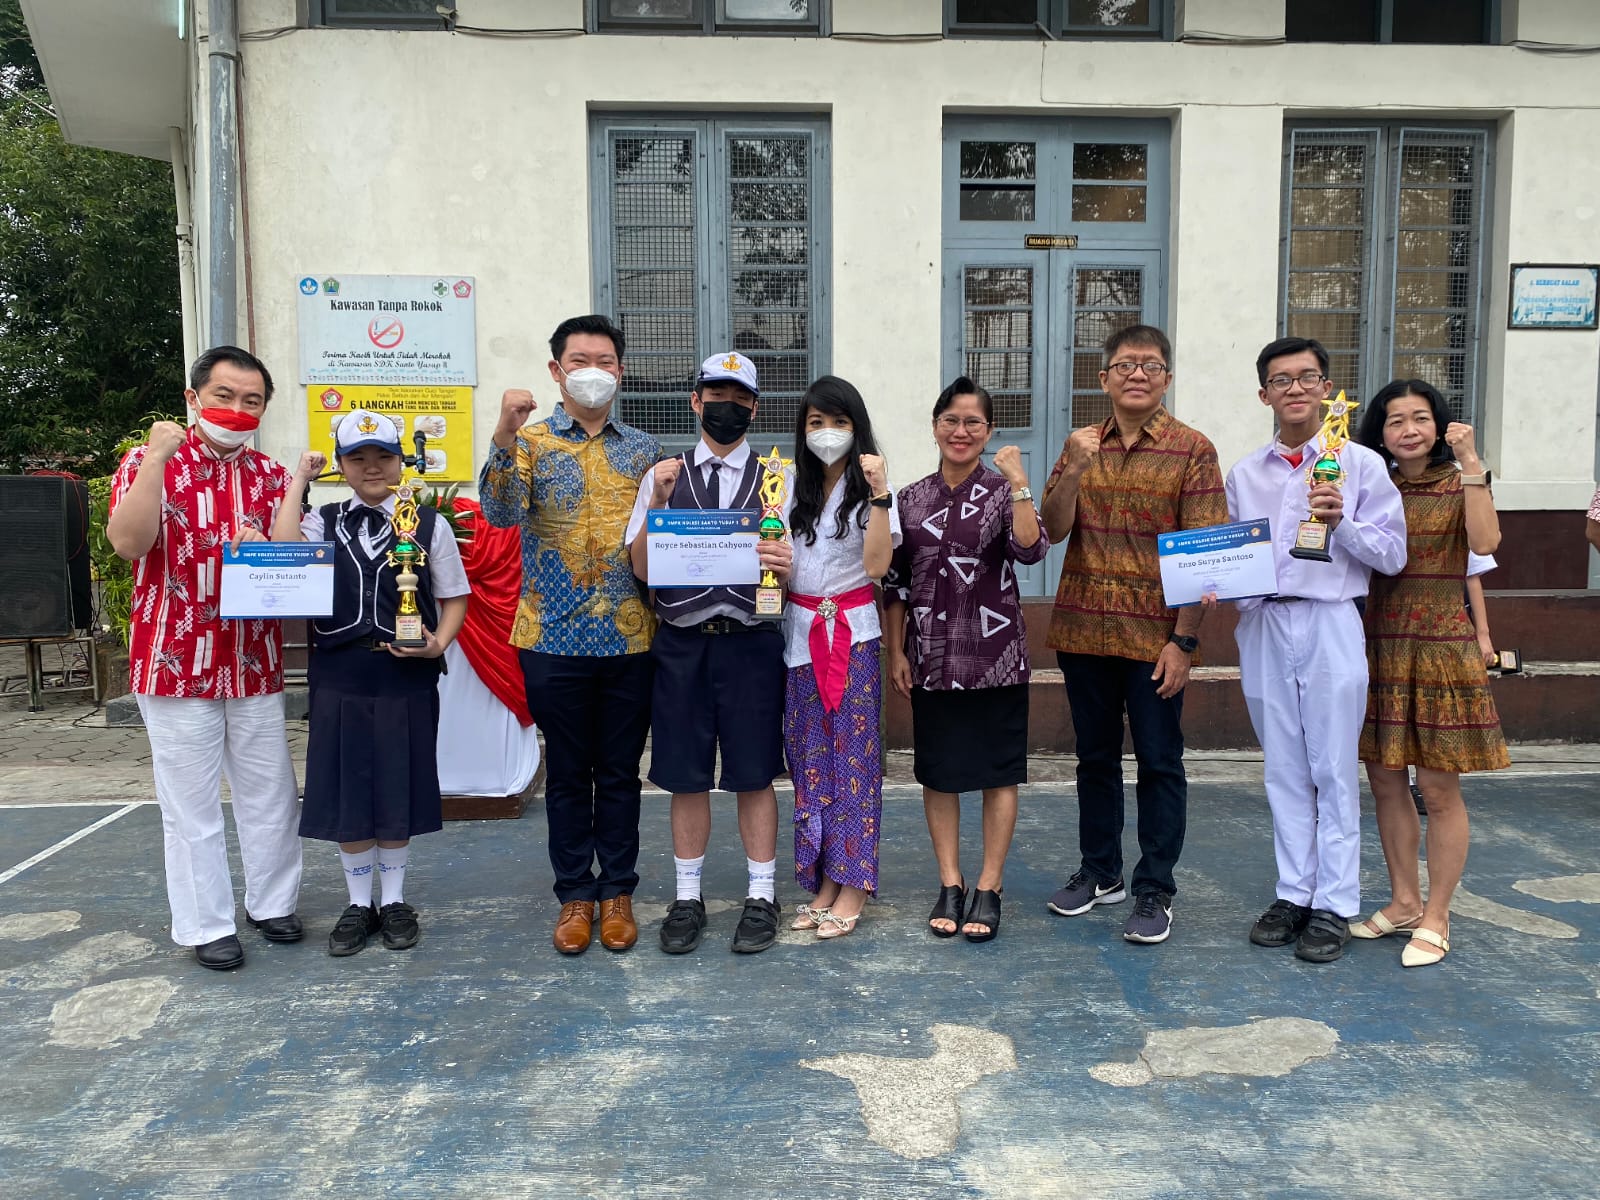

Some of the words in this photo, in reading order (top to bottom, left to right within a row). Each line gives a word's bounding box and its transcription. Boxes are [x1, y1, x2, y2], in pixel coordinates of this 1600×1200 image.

[330, 299, 375, 311] Kawasan
[378, 300, 408, 312] Tanpa
[411, 300, 443, 312] Rokok
[322, 351, 347, 359] Terima
[349, 351, 371, 359] Kasih
[372, 351, 395, 359] Untuk
[420, 352, 451, 360] Merokok
[328, 360, 335, 368] di
[336, 360, 372, 368] Kawasan
[374, 360, 394, 368] SDK
[350, 400, 356, 410] 6
[360, 400, 404, 410] LANGKAH
[655, 542, 678, 550] Royce
[679, 541, 717, 549] Sebastian
[718, 541, 753, 550] Cahyono
[1178, 561, 1197, 569] Enzo
[1197, 558, 1221, 567] Surya
[1222, 553, 1254, 563] Santoso
[249, 572, 274, 582] Caylin
[275, 572, 307, 581] Sutanto
